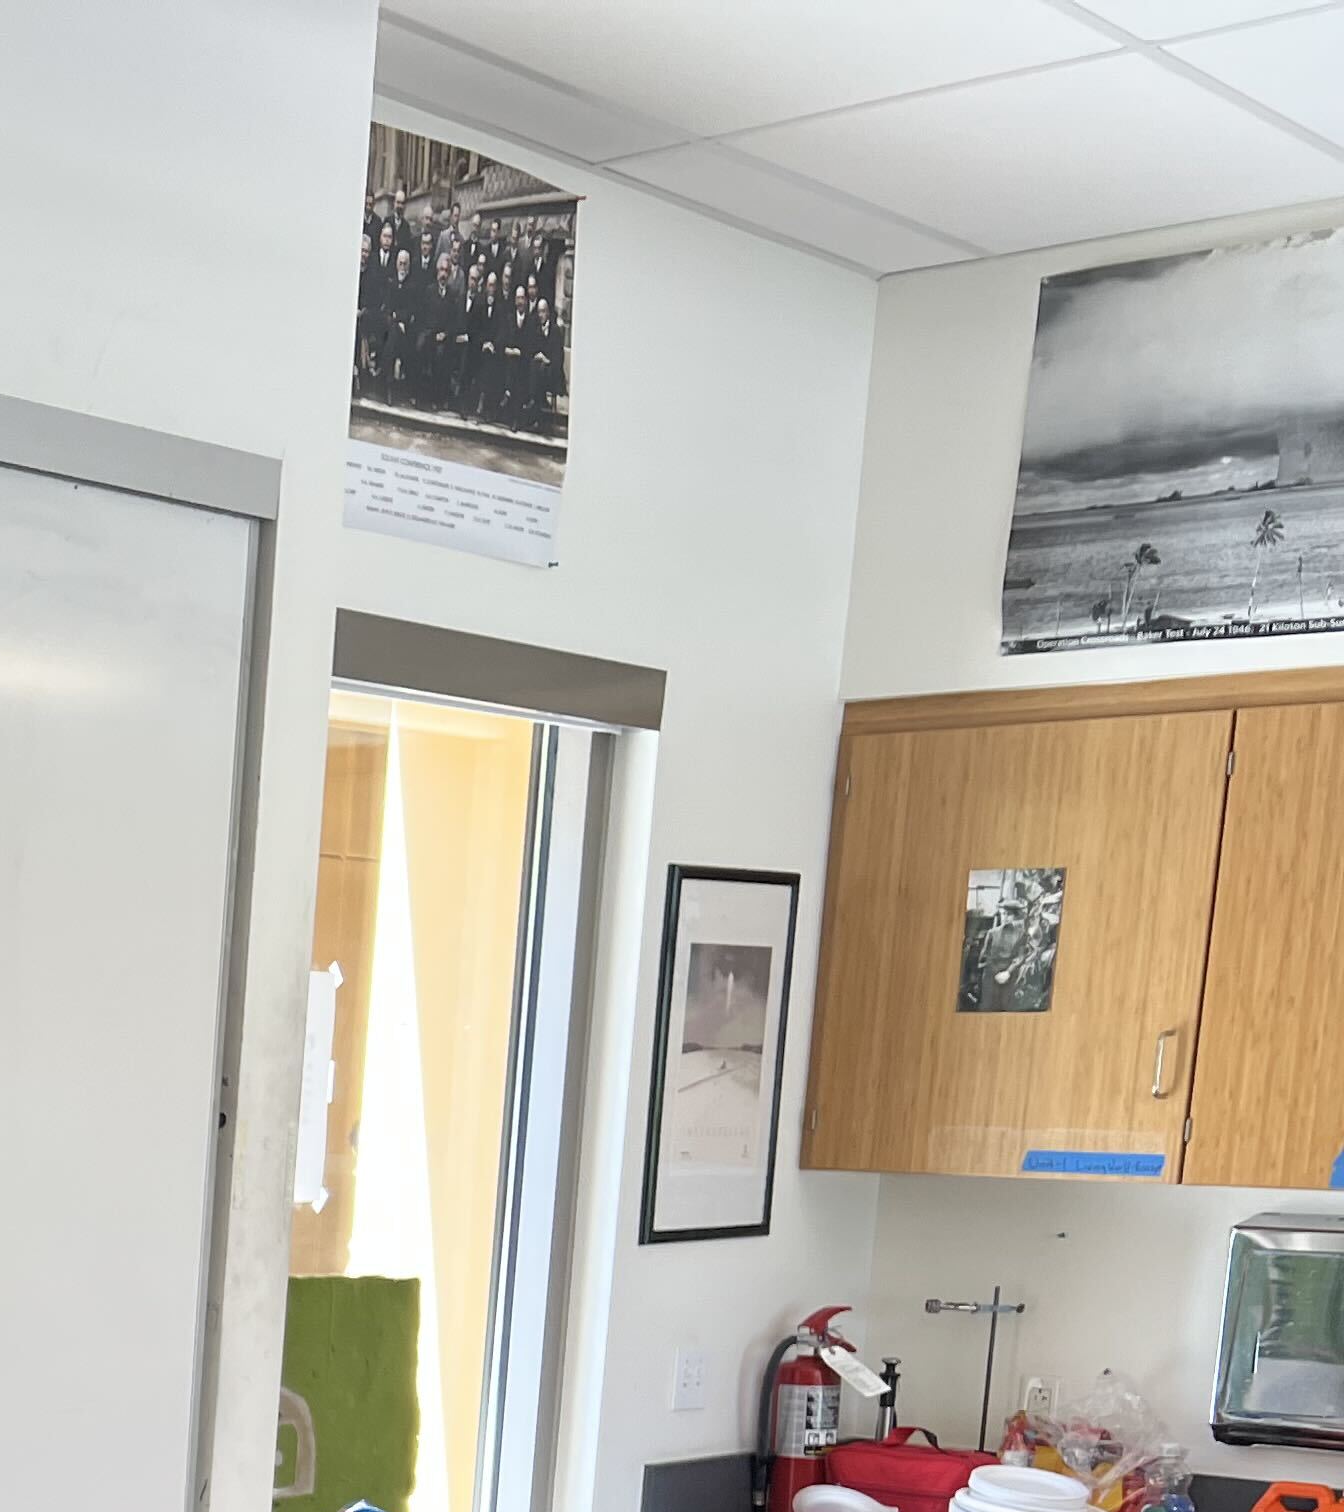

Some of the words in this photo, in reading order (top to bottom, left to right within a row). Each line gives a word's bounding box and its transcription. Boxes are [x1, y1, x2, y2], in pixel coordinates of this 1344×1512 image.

[1165, 627, 1185, 639] Test
[1192, 625, 1212, 638] July
[1213, 624, 1225, 636] 24
[1271, 620, 1306, 633] Kiloton
